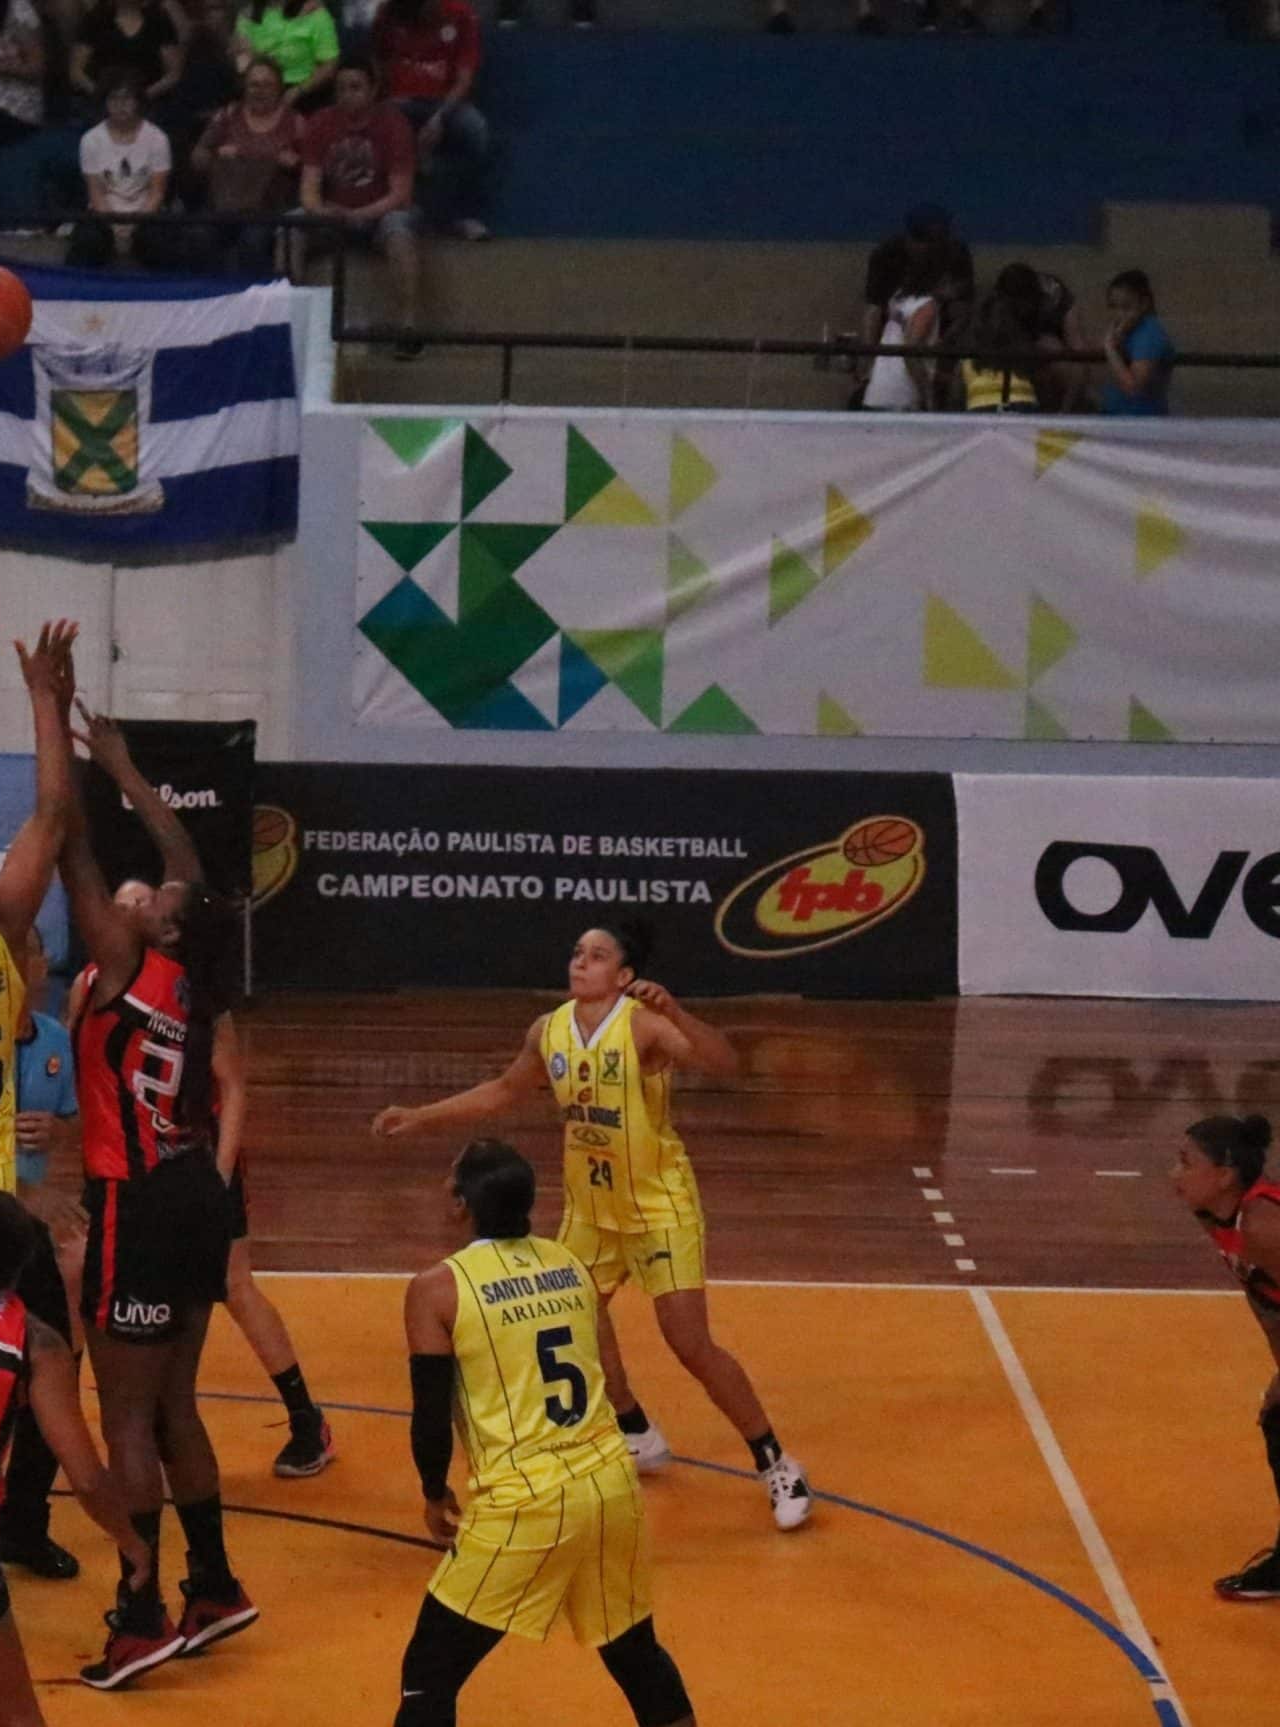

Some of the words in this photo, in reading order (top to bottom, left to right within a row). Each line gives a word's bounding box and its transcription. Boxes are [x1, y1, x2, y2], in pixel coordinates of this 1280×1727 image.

[303, 827, 441, 858] FEDERAÇÃO
[447, 832, 556, 854] PAULISTA
[562, 834, 593, 856] DE
[599, 836, 748, 859] BASKETBALL
[316, 873, 544, 899] CAMPEONATO
[554, 876, 713, 904] PAULISTA
[587, 1157, 614, 1191] 24
[481, 1277, 536, 1306] SANTO
[501, 1295, 585, 1327] ARIADNA
[536, 1325, 589, 1429] 5
